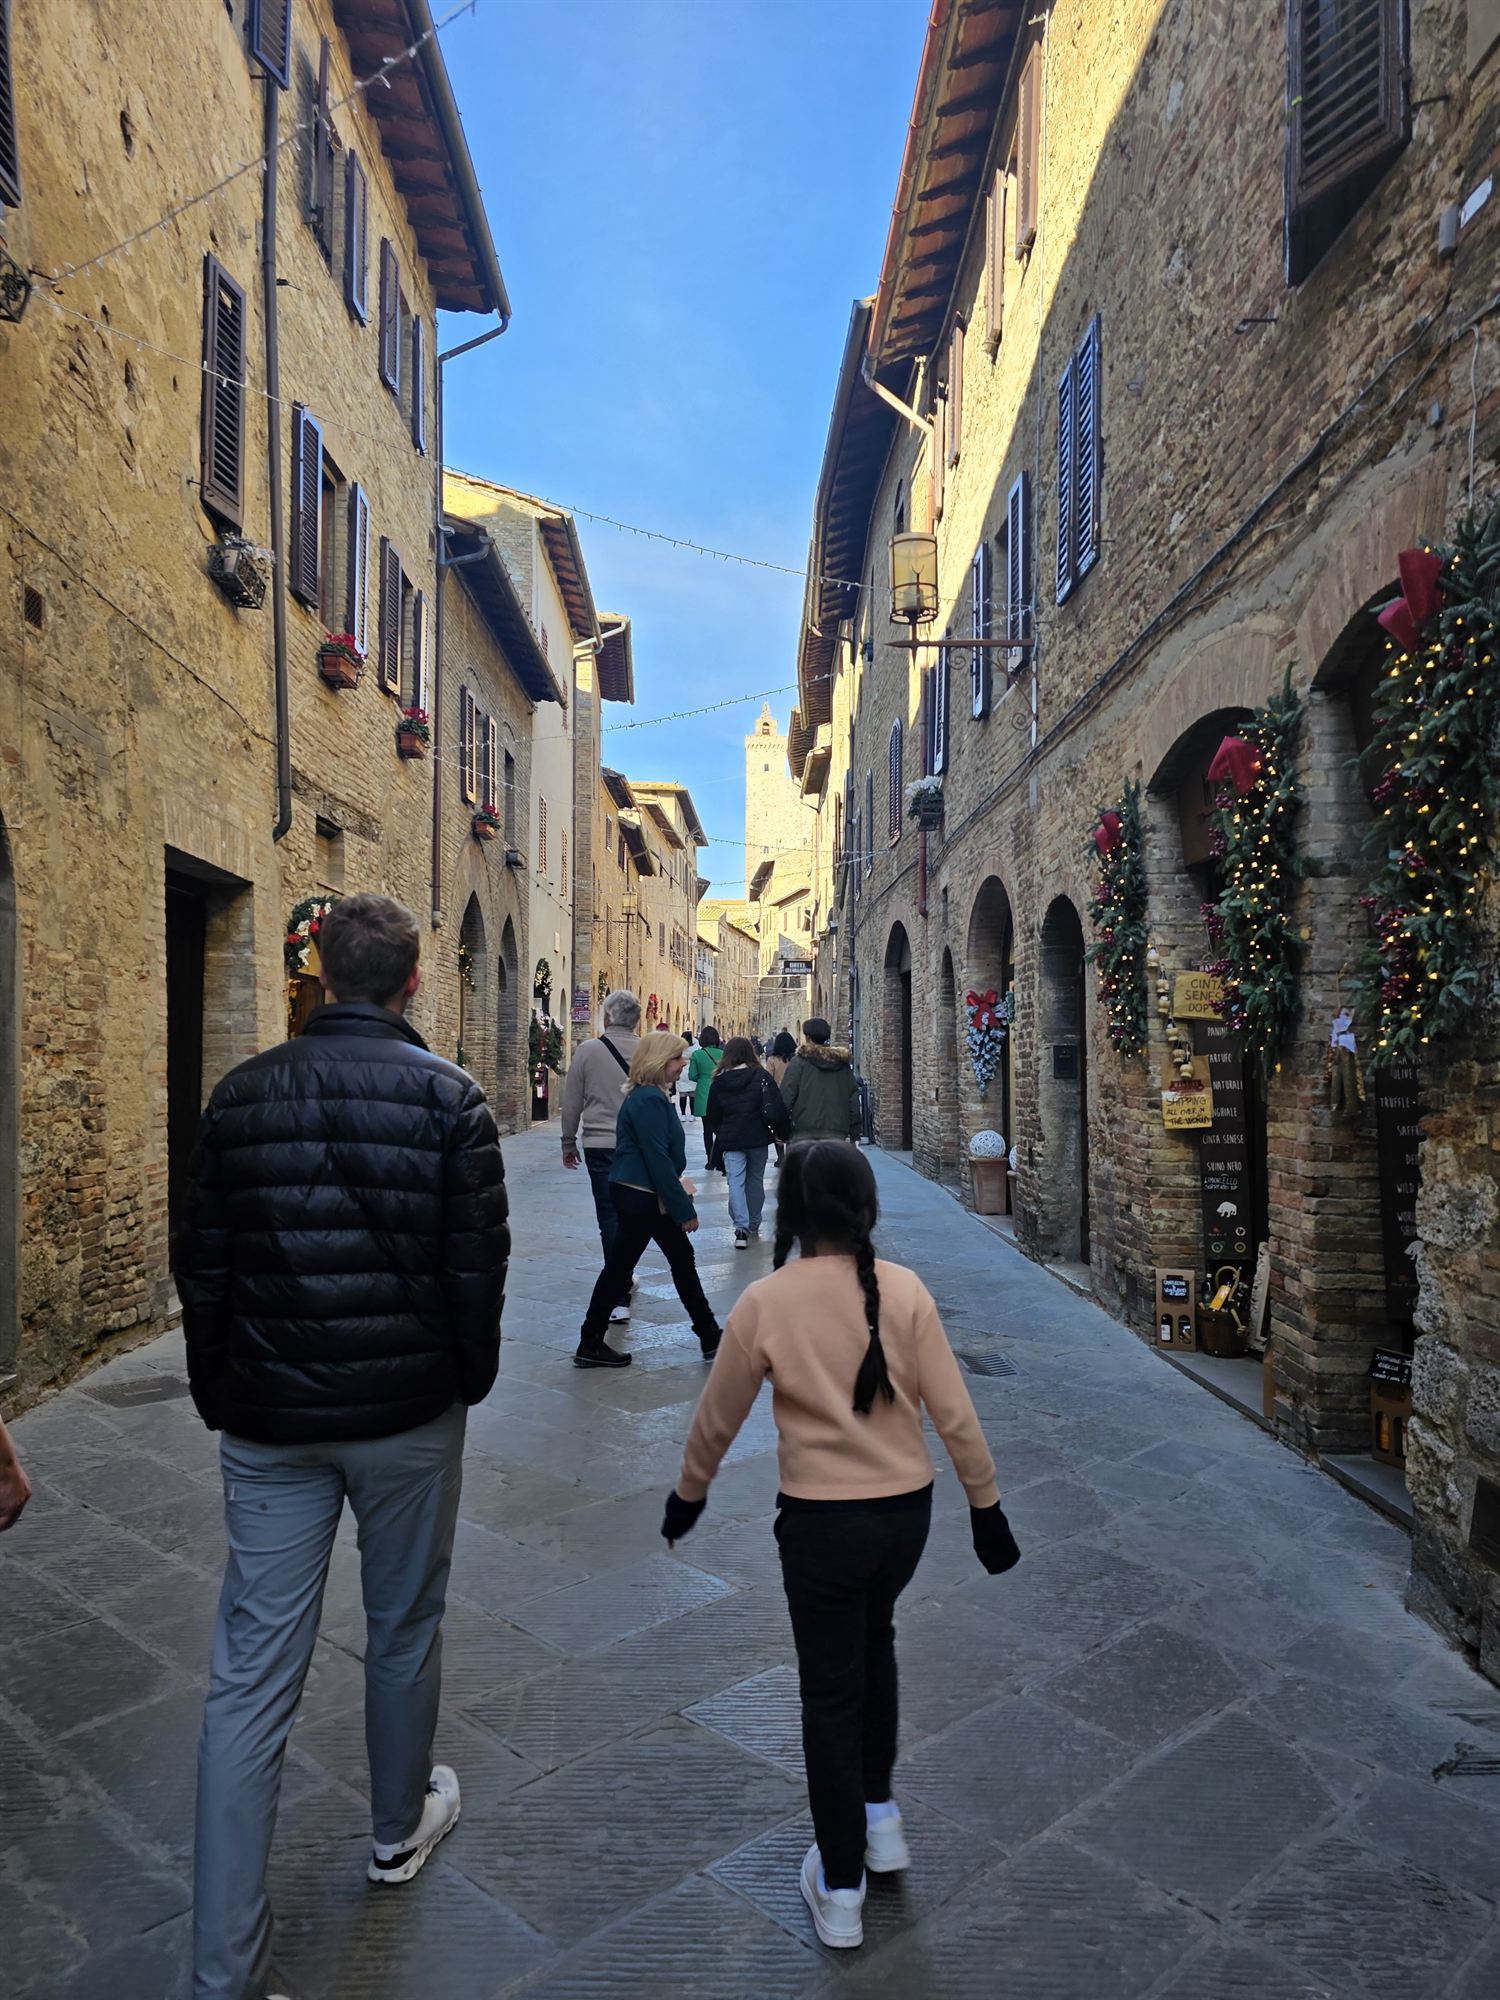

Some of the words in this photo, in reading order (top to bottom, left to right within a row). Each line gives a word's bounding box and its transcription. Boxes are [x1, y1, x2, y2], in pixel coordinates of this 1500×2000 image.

[1184, 990, 1221, 1001] SENES
[1380, 1097, 1410, 1108] TRUFFLE
[1202, 1134, 1221, 1145] CINTA
[1222, 1134, 1244, 1145] SENESE
